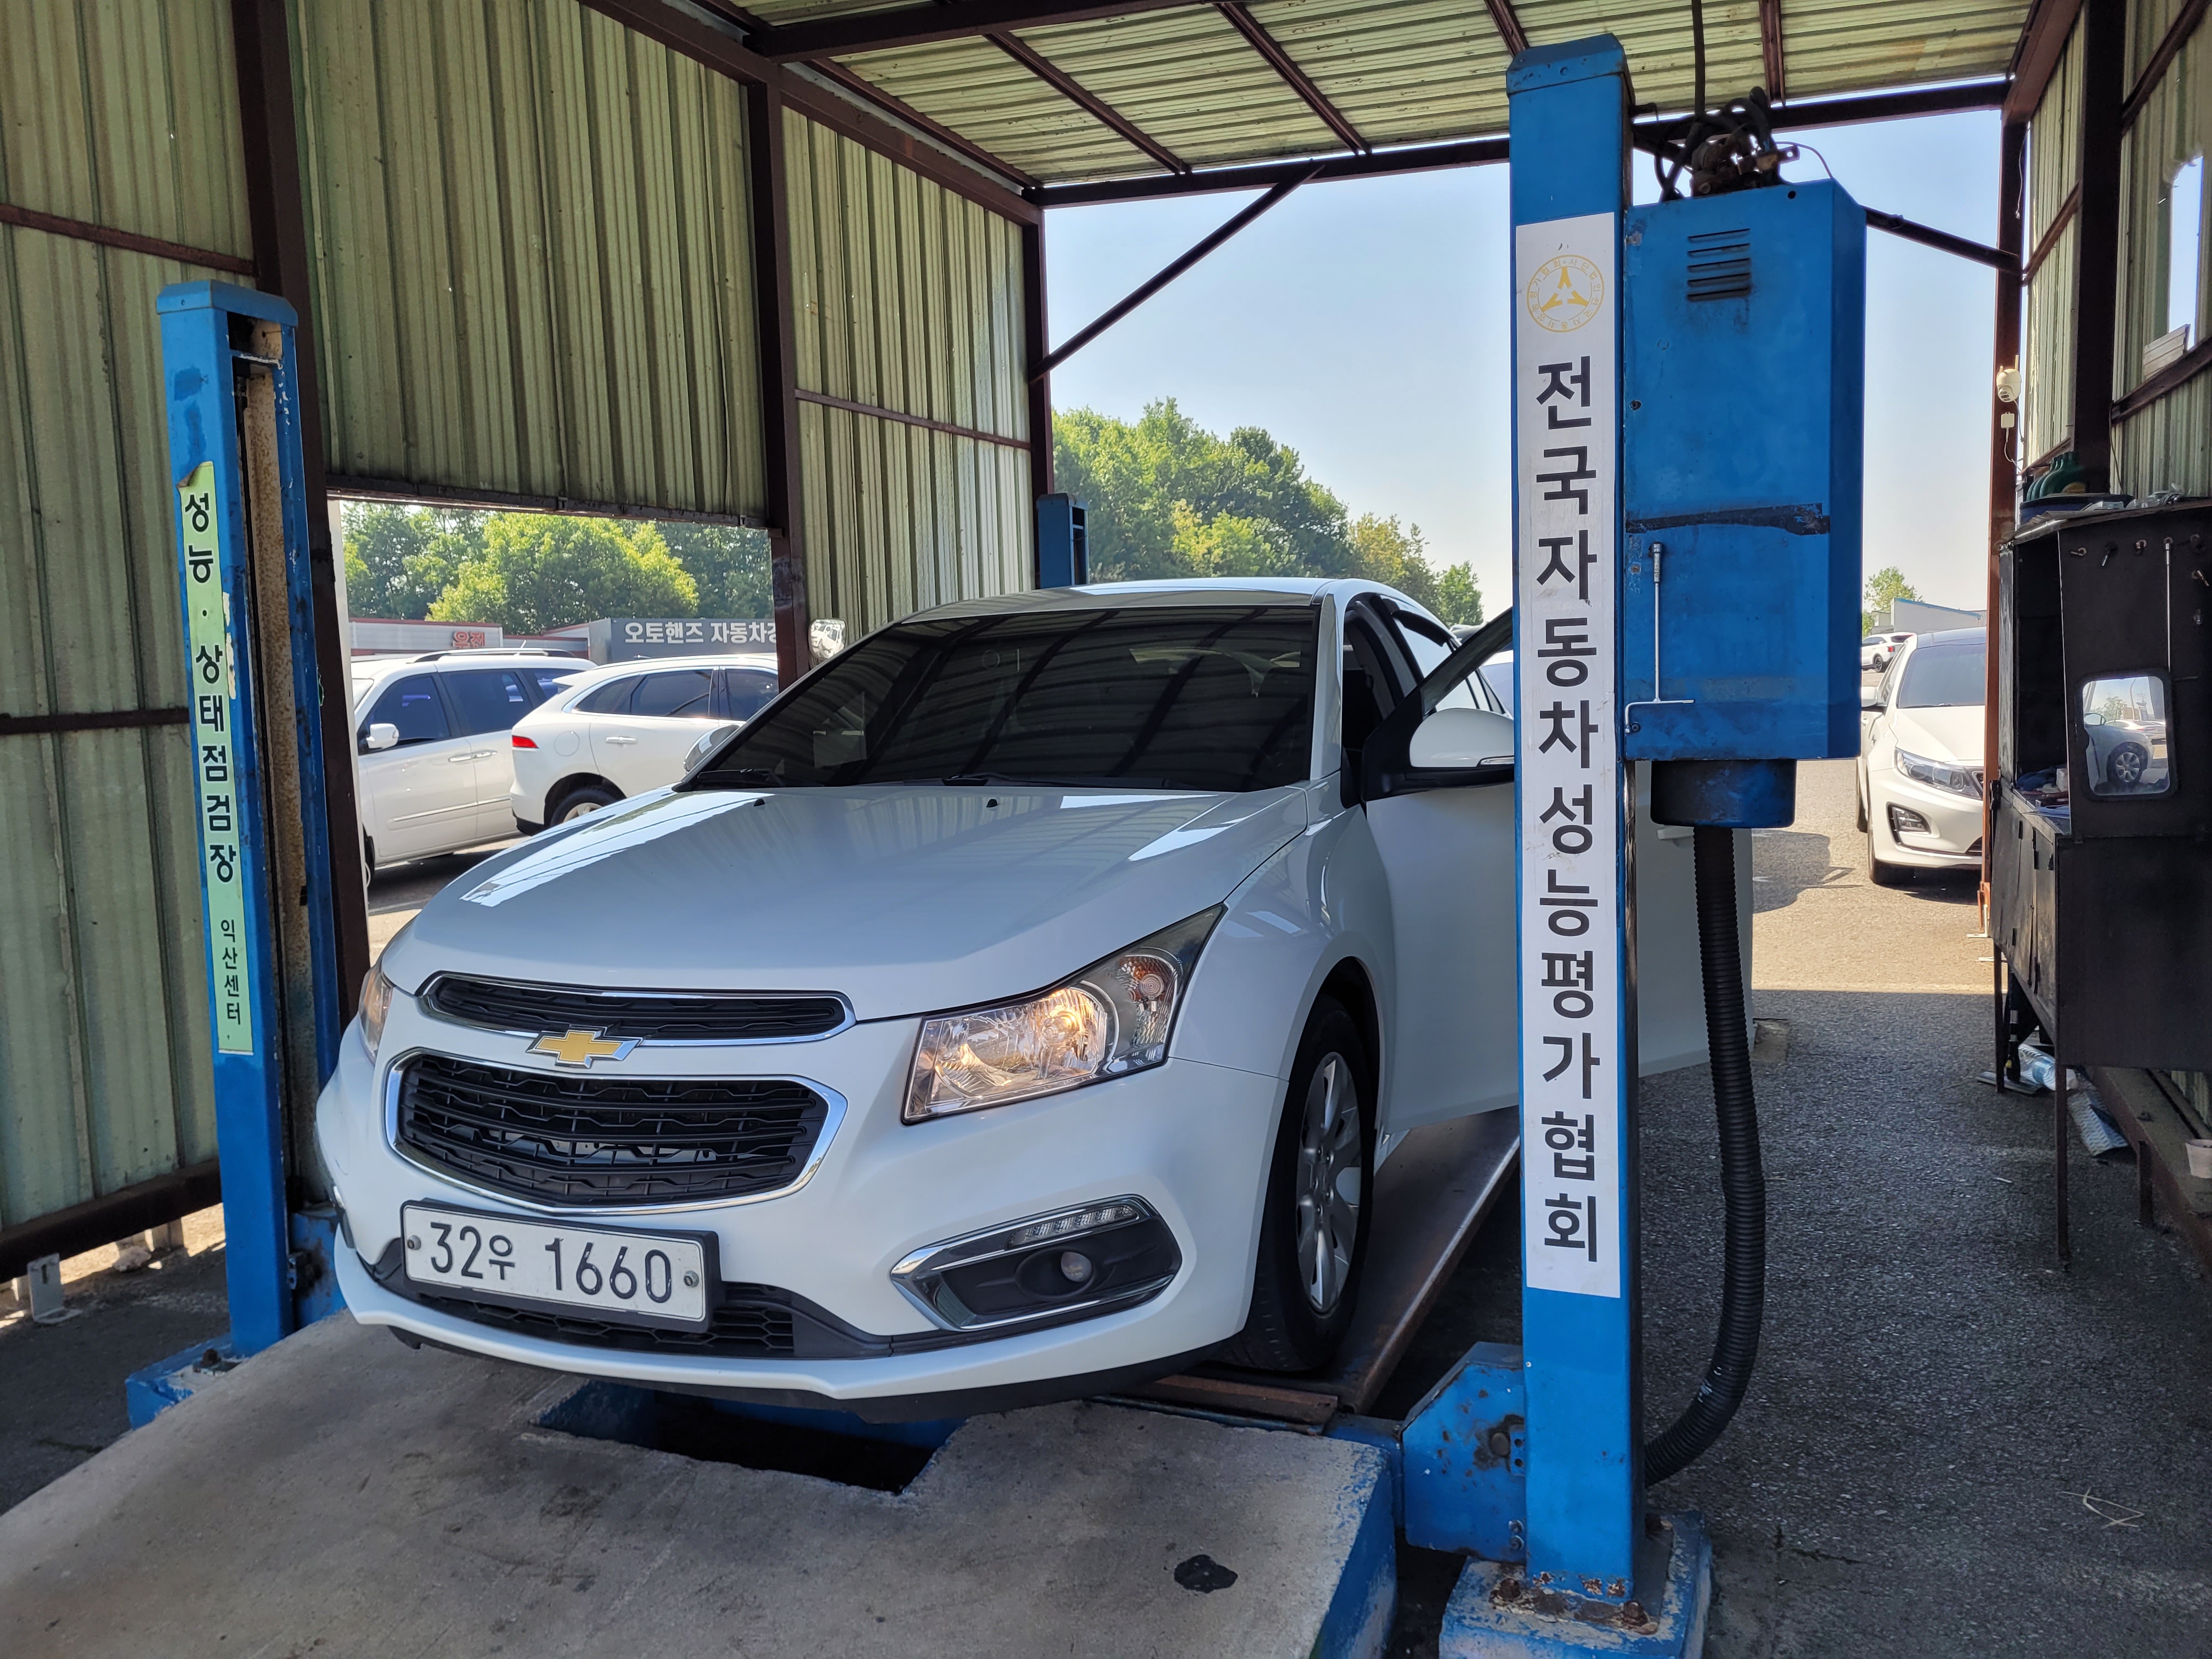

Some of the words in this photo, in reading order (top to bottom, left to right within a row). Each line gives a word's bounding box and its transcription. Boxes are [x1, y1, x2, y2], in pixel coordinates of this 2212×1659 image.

[625, 622, 704, 644] 오토핸즈
[1536, 356, 1600, 1262] 전국자동차성능평가협회
[221, 919, 241, 1025] 익산센터
[430, 1222, 515, 1280] 32우
[545, 1238, 672, 1303] 1660
